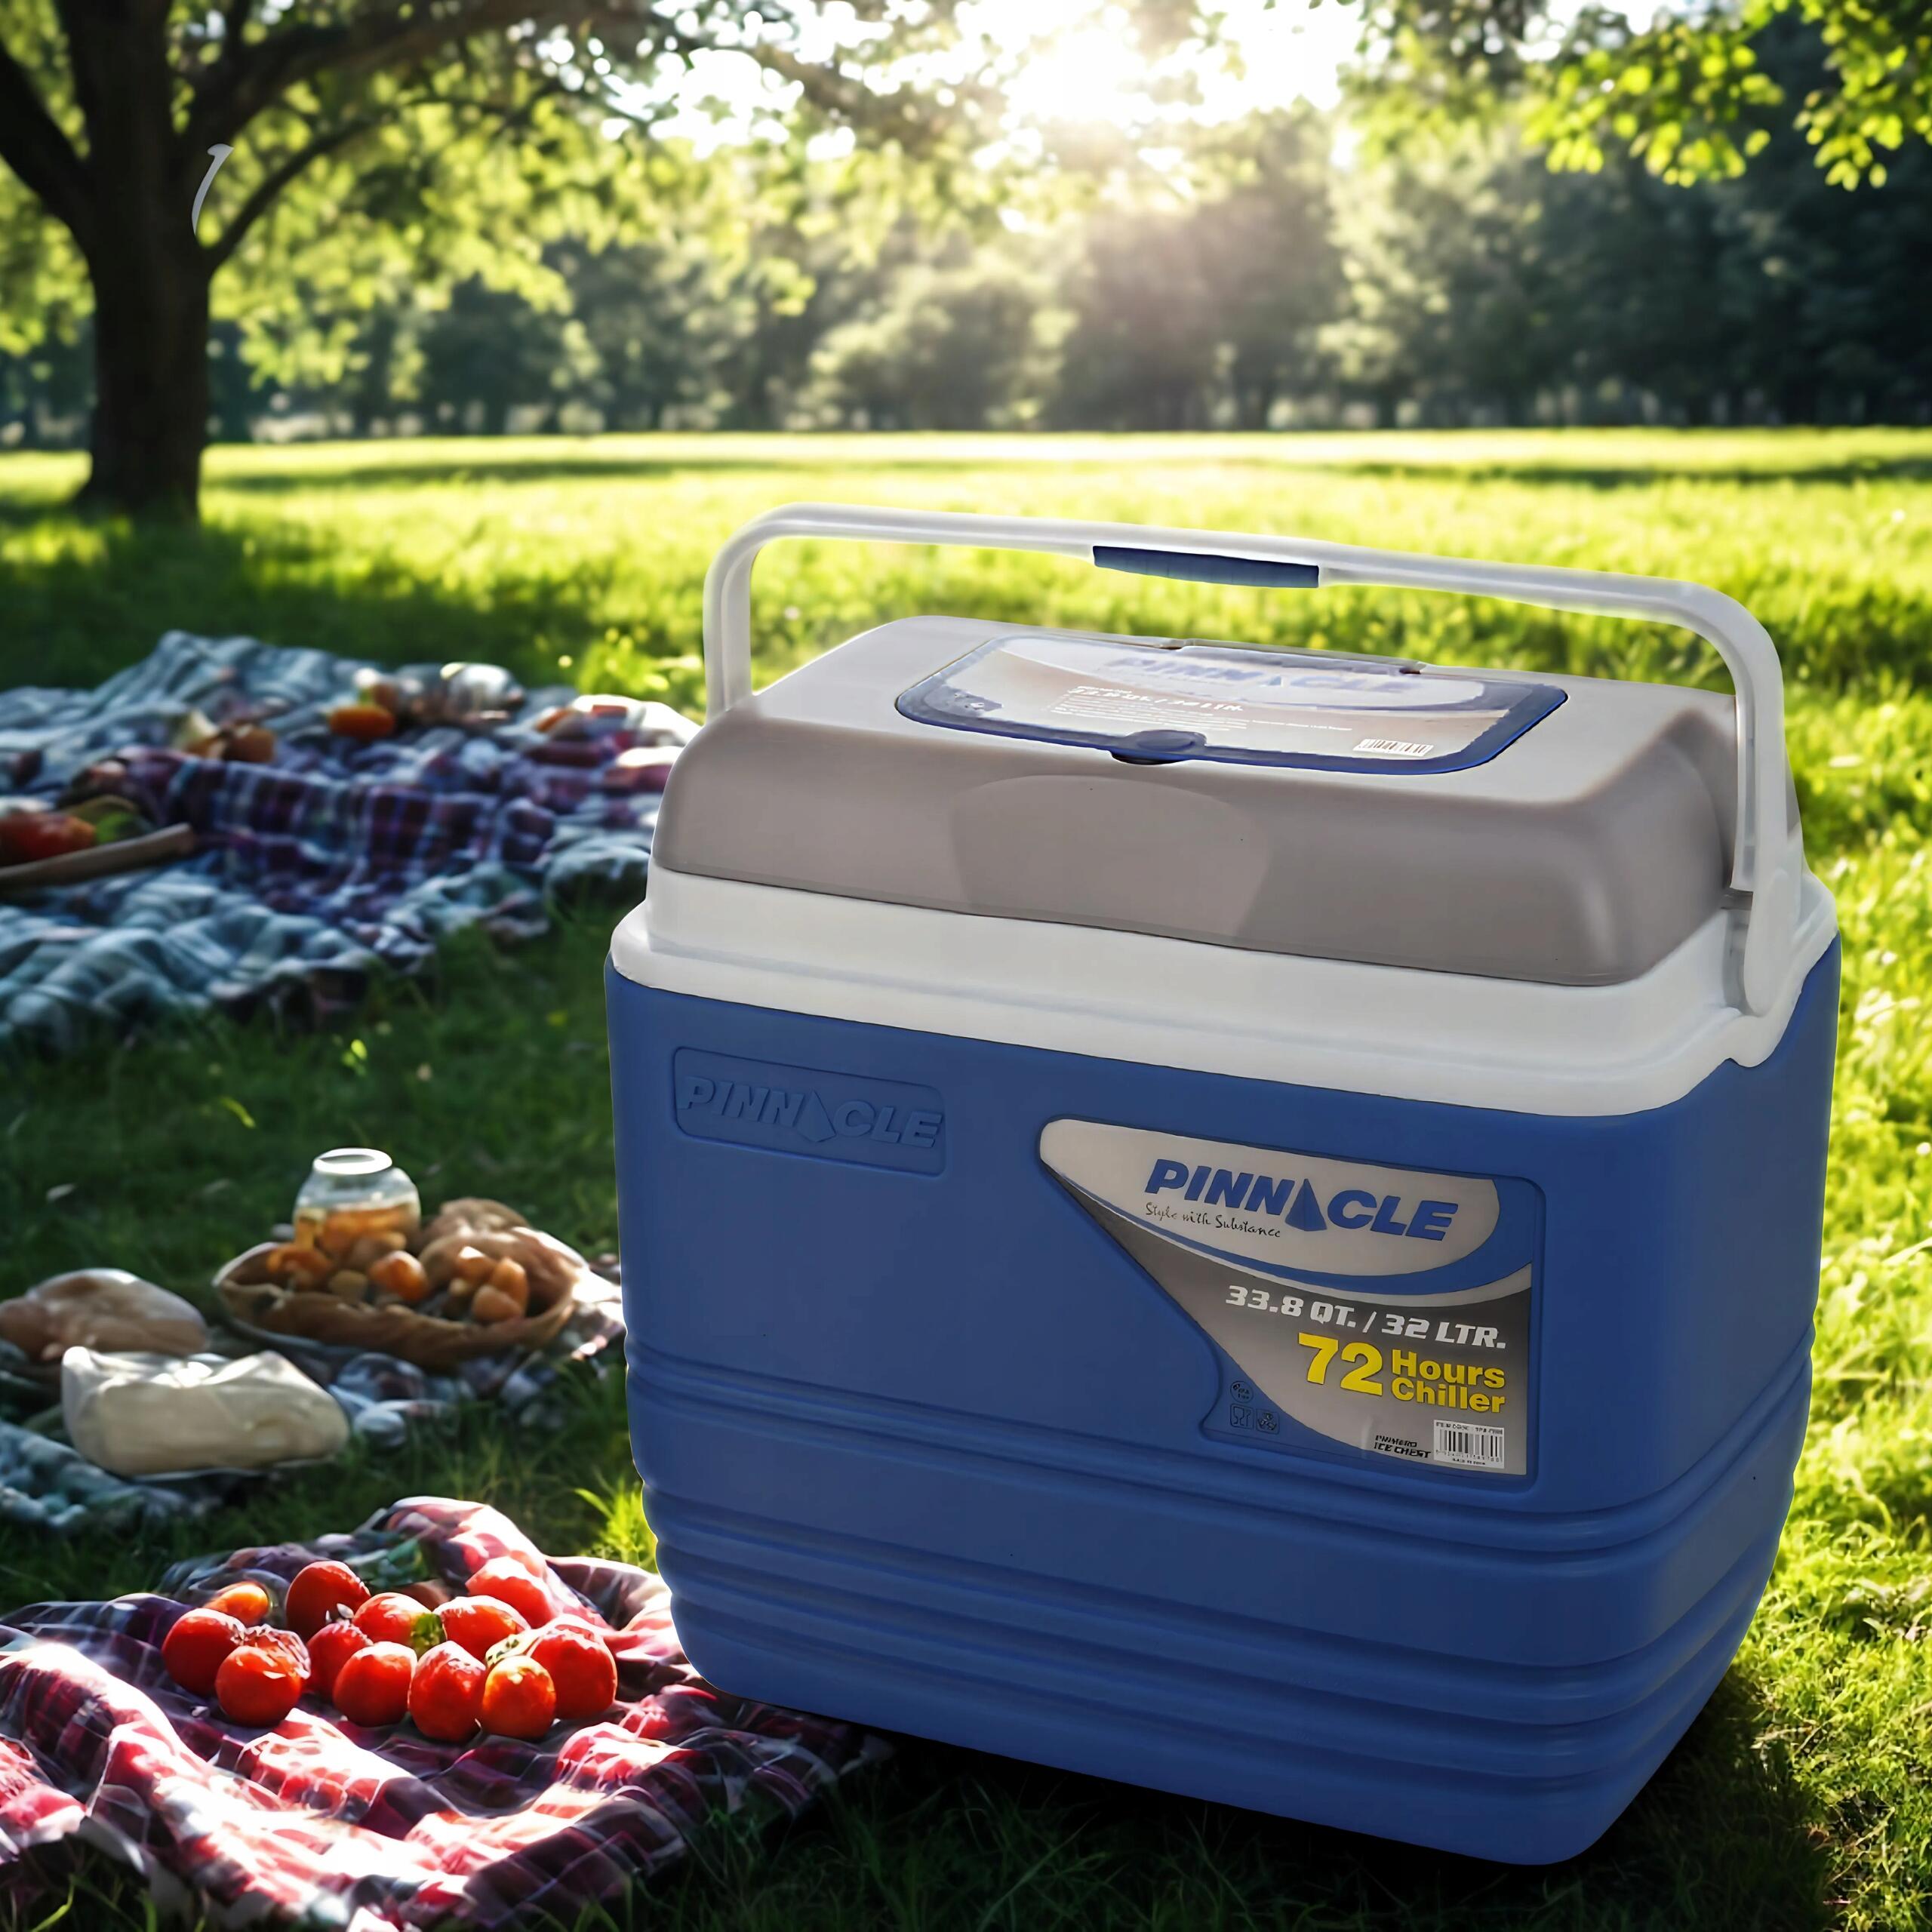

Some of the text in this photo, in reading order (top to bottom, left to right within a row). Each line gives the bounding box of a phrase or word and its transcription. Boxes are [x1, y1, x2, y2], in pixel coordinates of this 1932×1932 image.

[677, 1075, 943, 1148] PINNACLE
[1145, 1158, 1459, 1241] PINNACLE
[1146, 1201, 1281, 1238] Style with Substance
[1225, 1284, 1506, 1349] 33.8 QT. / 32 LTR.
[1297, 1332, 1383, 1396] 72
[1392, 1349, 1505, 1389] Hours
[1391, 1377, 1506, 1414] Chiller
[1374, 1441, 1393, 1452] ICE
[1394, 1446, 1432, 1458] CHEST
